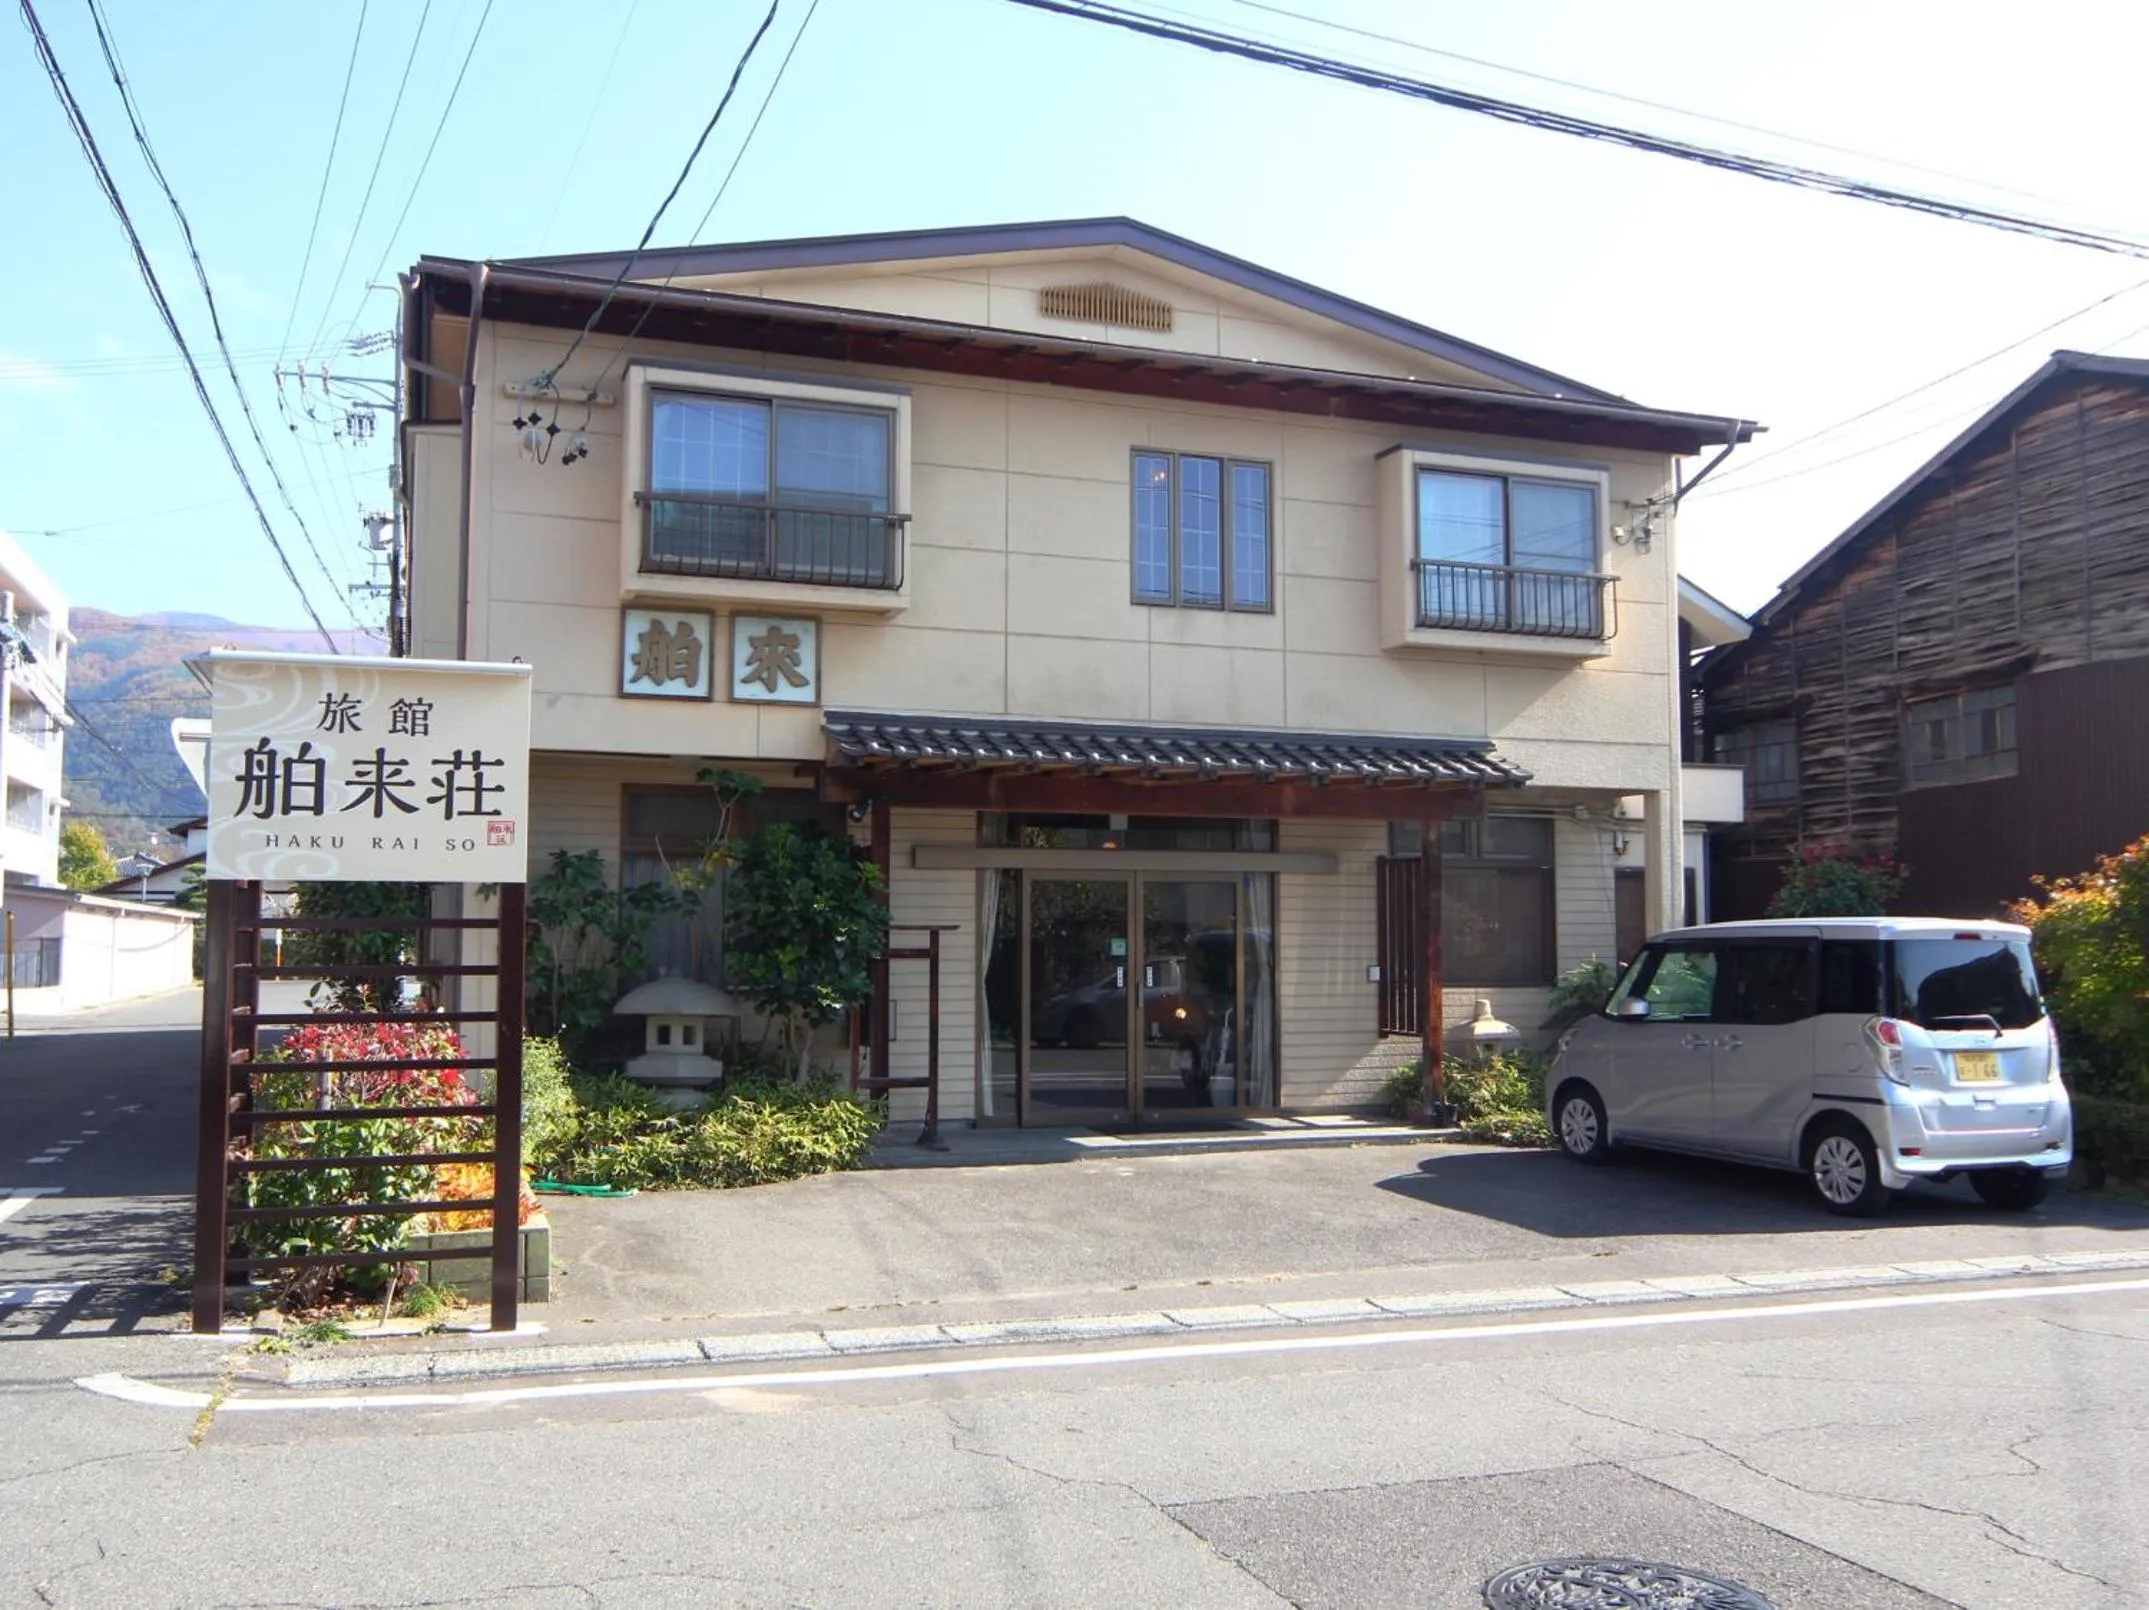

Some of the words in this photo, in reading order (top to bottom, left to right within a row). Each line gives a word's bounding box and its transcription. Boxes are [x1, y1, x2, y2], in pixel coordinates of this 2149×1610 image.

[316, 691, 434, 737] 旅館
[233, 736, 505, 821] 舶来荘
[265, 834, 345, 849] HAKU
[372, 836, 419, 850] RAI
[446, 838, 475, 852] SO
